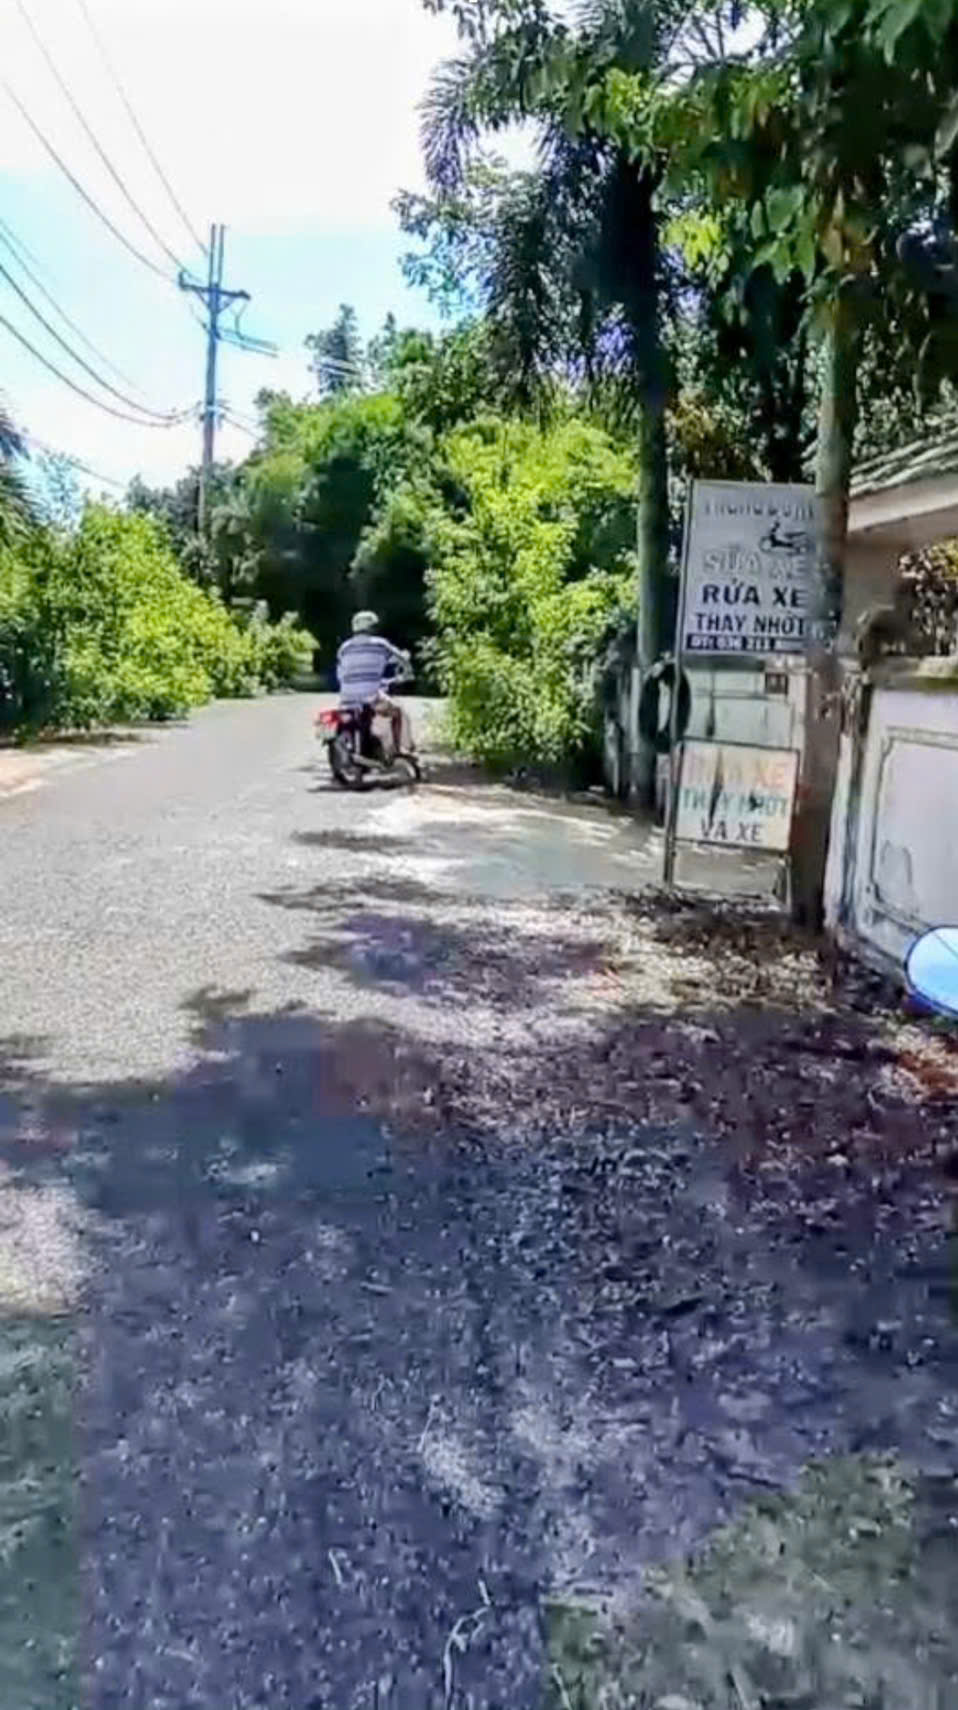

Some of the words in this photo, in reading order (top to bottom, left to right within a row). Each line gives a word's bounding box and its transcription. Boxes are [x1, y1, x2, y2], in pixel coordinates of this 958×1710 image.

[773, 587, 807, 608] XE
[695, 612, 746, 632] THAY
[683, 788, 734, 811] THY
[736, 822, 763, 842] XE
